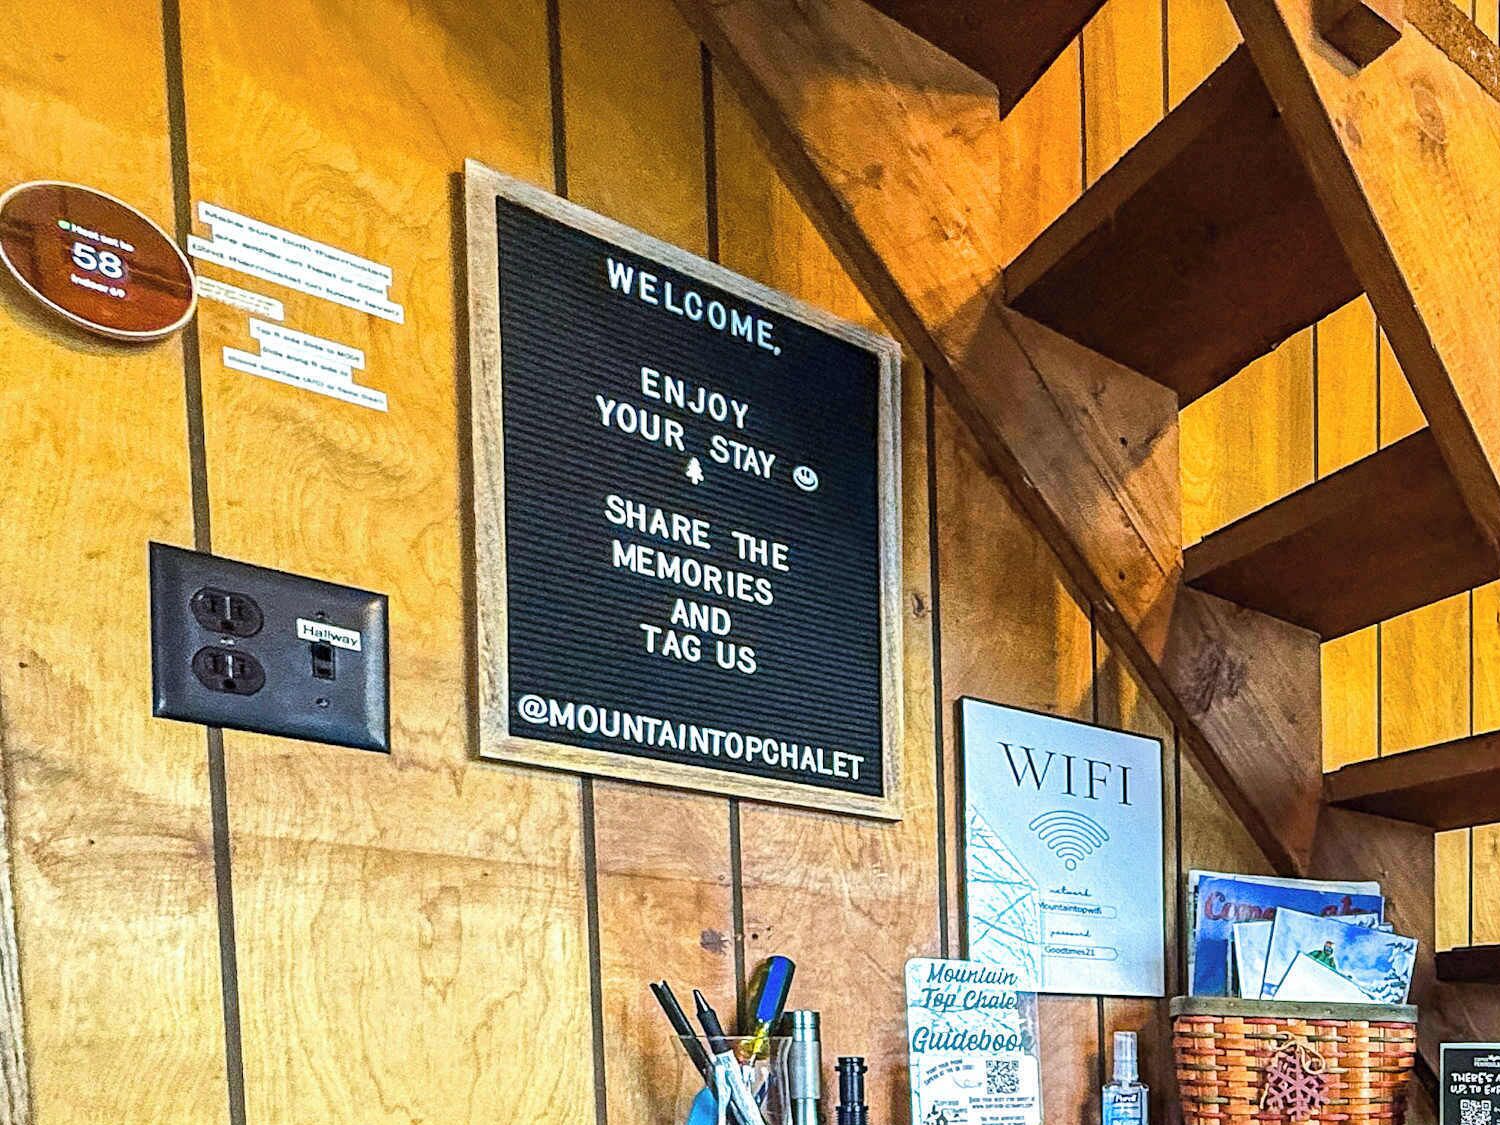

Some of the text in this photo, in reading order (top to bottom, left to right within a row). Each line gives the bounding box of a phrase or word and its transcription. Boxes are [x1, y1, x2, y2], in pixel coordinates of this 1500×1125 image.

[72, 241, 124, 279] 58
[640, 366, 750, 430] ENJOY
[595, 394, 777, 479] YOUR STAY
[604, 494, 791, 573] SHARE THE
[611, 539, 775, 607] MEMORIES
[302, 623, 361, 647] Hallway
[669, 597, 732, 637] AND
[638, 623, 758, 675] TAG US
[517, 693, 865, 781] @MOUNTAINTOPCHALET
[996, 741, 1134, 807] WIFI
[921, 987, 1019, 1013] Top Chale
[927, 962, 1019, 986] Mountain
